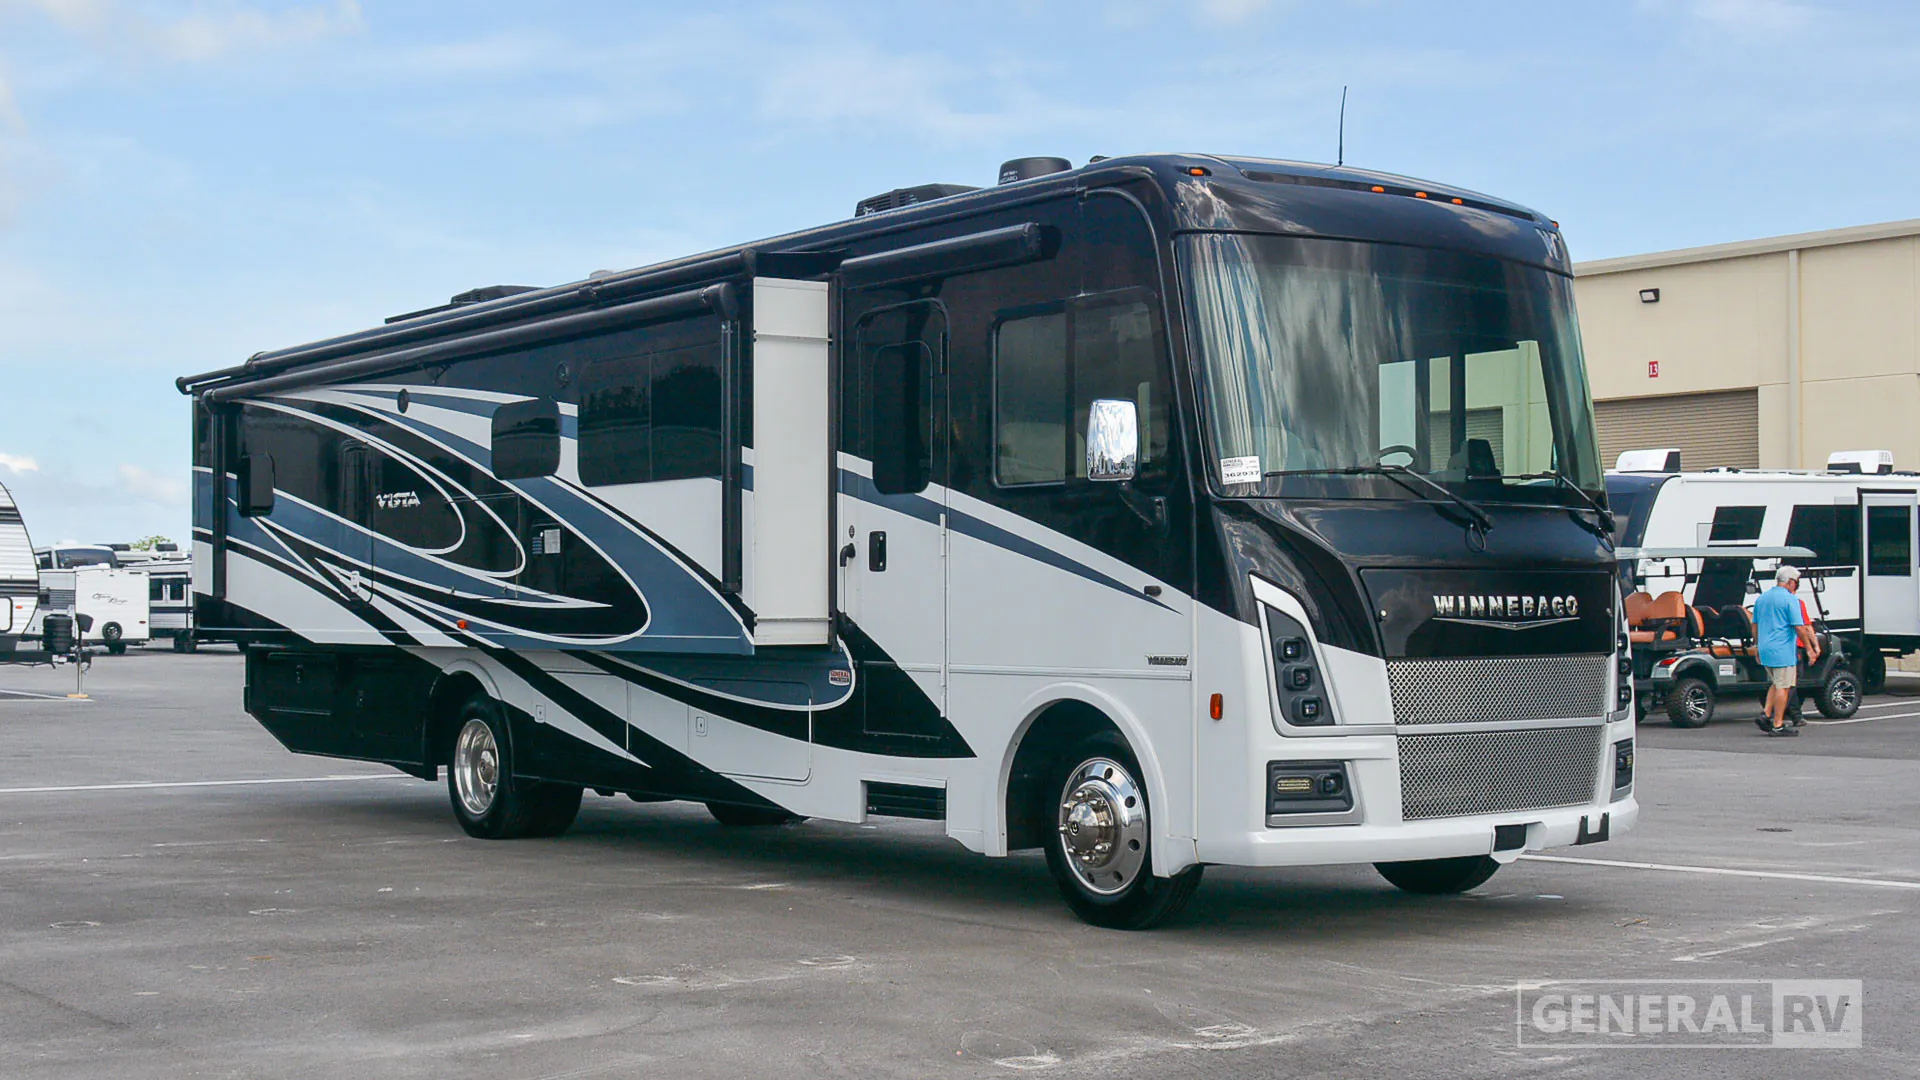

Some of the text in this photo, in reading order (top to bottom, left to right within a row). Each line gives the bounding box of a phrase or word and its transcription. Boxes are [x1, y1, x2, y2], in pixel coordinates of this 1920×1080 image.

[1649, 363, 1658, 376] 13
[375, 490, 421, 509] VISTA
[1432, 595, 1578, 617] WINNEBAGO
